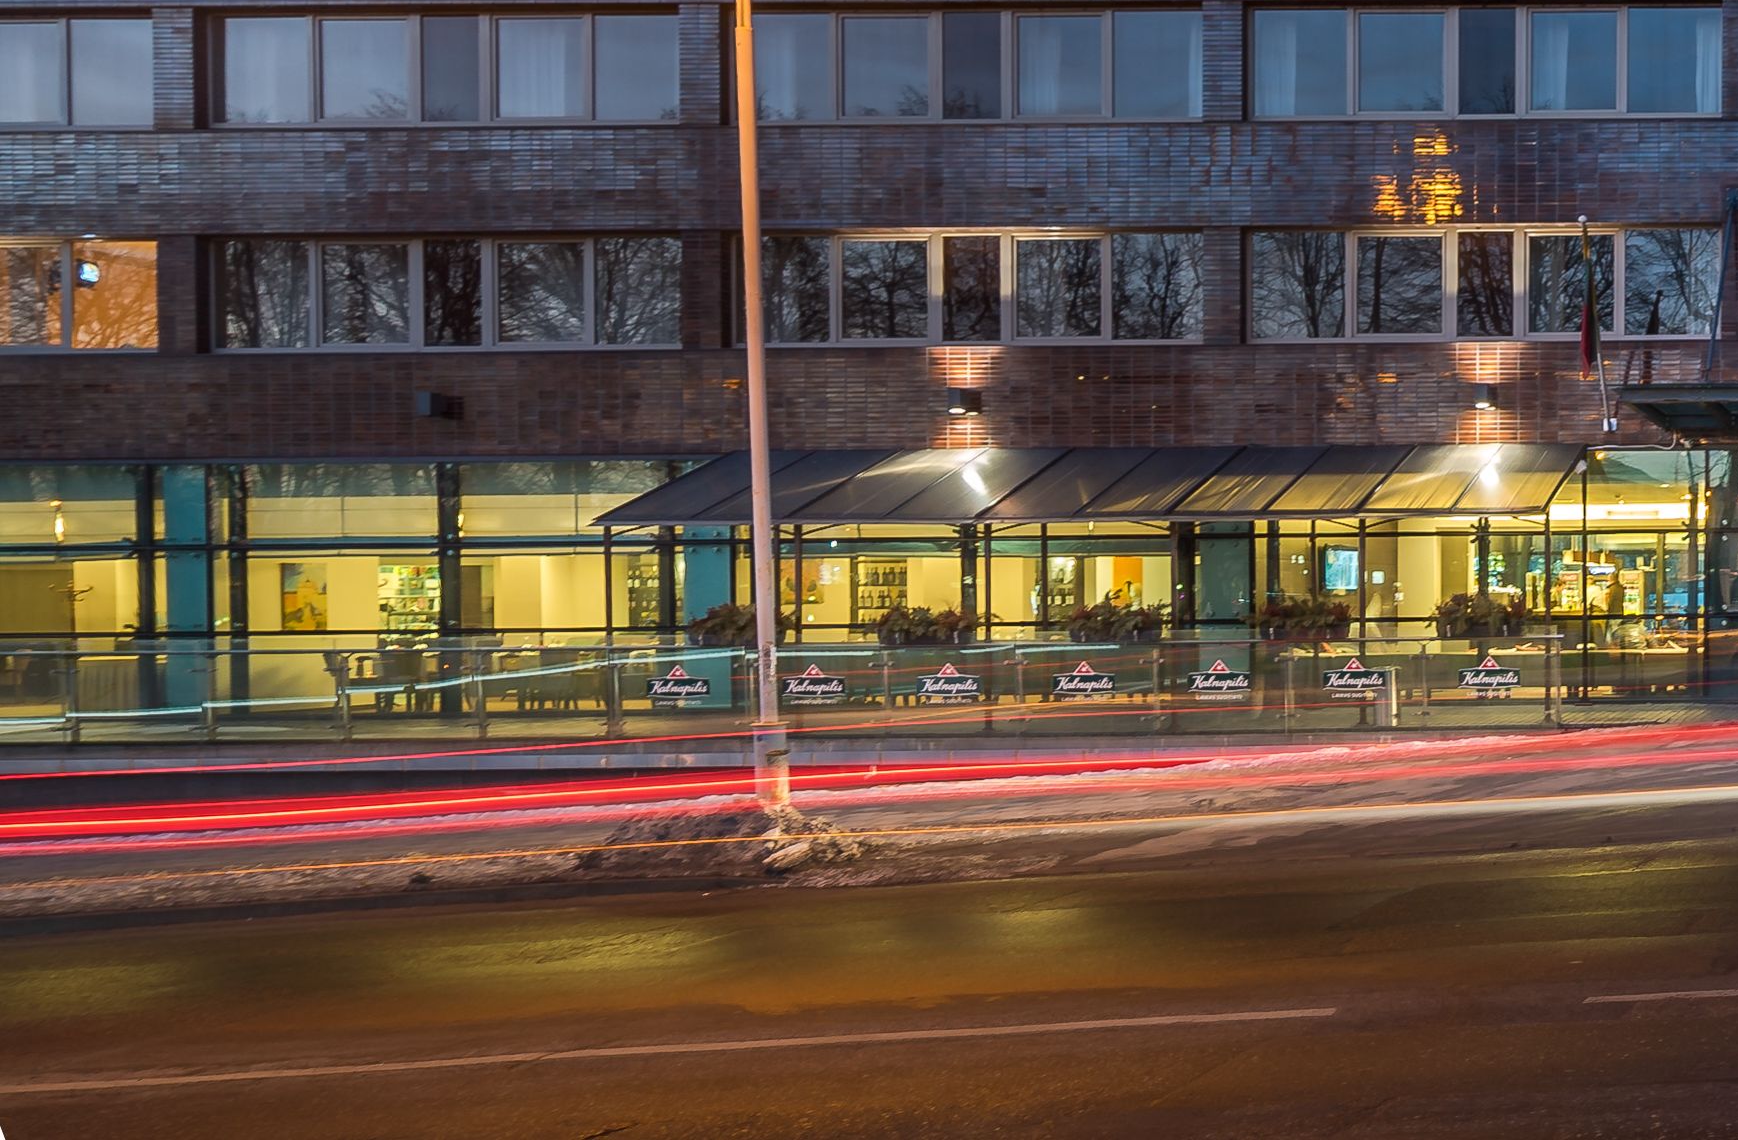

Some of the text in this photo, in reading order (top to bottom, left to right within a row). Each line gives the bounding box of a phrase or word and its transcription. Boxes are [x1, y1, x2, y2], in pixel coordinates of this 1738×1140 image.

[649, 679, 708, 696] Kalnapilis
[785, 678, 844, 695] Kalnapilis
[920, 677, 979, 694] Kalnapilis
[1055, 676, 1115, 694] Kalnapilis
[1190, 675, 1249, 691] Kalnapilis
[1325, 672, 1384, 690] Kalnapilis
[1460, 671, 1519, 688] Kalnapilis
